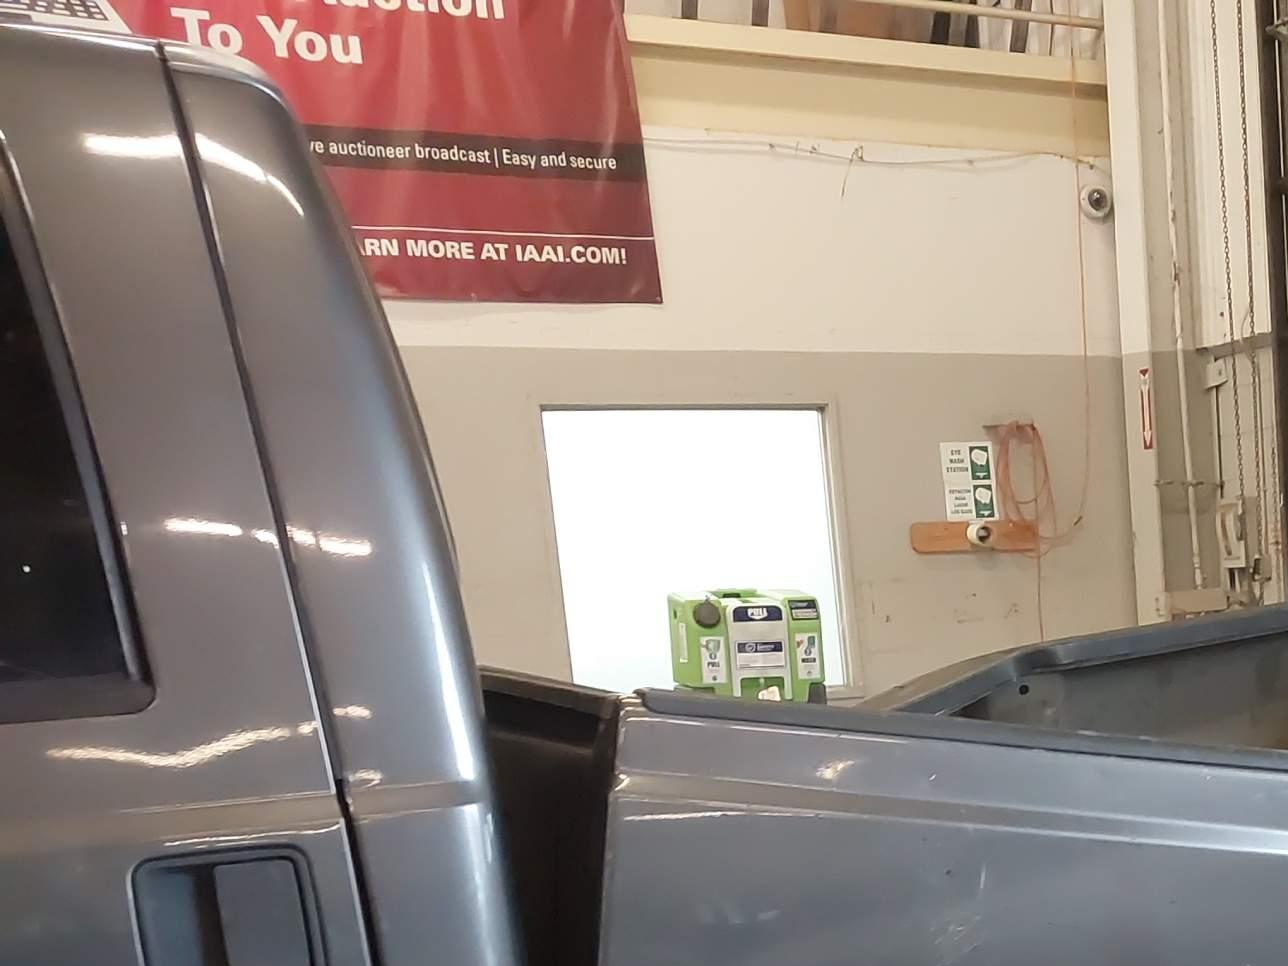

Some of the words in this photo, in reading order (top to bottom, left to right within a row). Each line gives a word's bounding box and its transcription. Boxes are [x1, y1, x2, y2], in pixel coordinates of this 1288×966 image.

[170, 7, 243, 54] To
[256, 15, 364, 64] You
[329, 140, 411, 159] auctioneer
[414, 143, 491, 164] broadcast
[502, 148, 537, 170] Easy
[540, 151, 567, 168] and
[569, 155, 617, 170] secure
[405, 239, 475, 260] MORE
[480, 243, 508, 261] AT
[515, 244, 627, 265] IAAI.COM!
